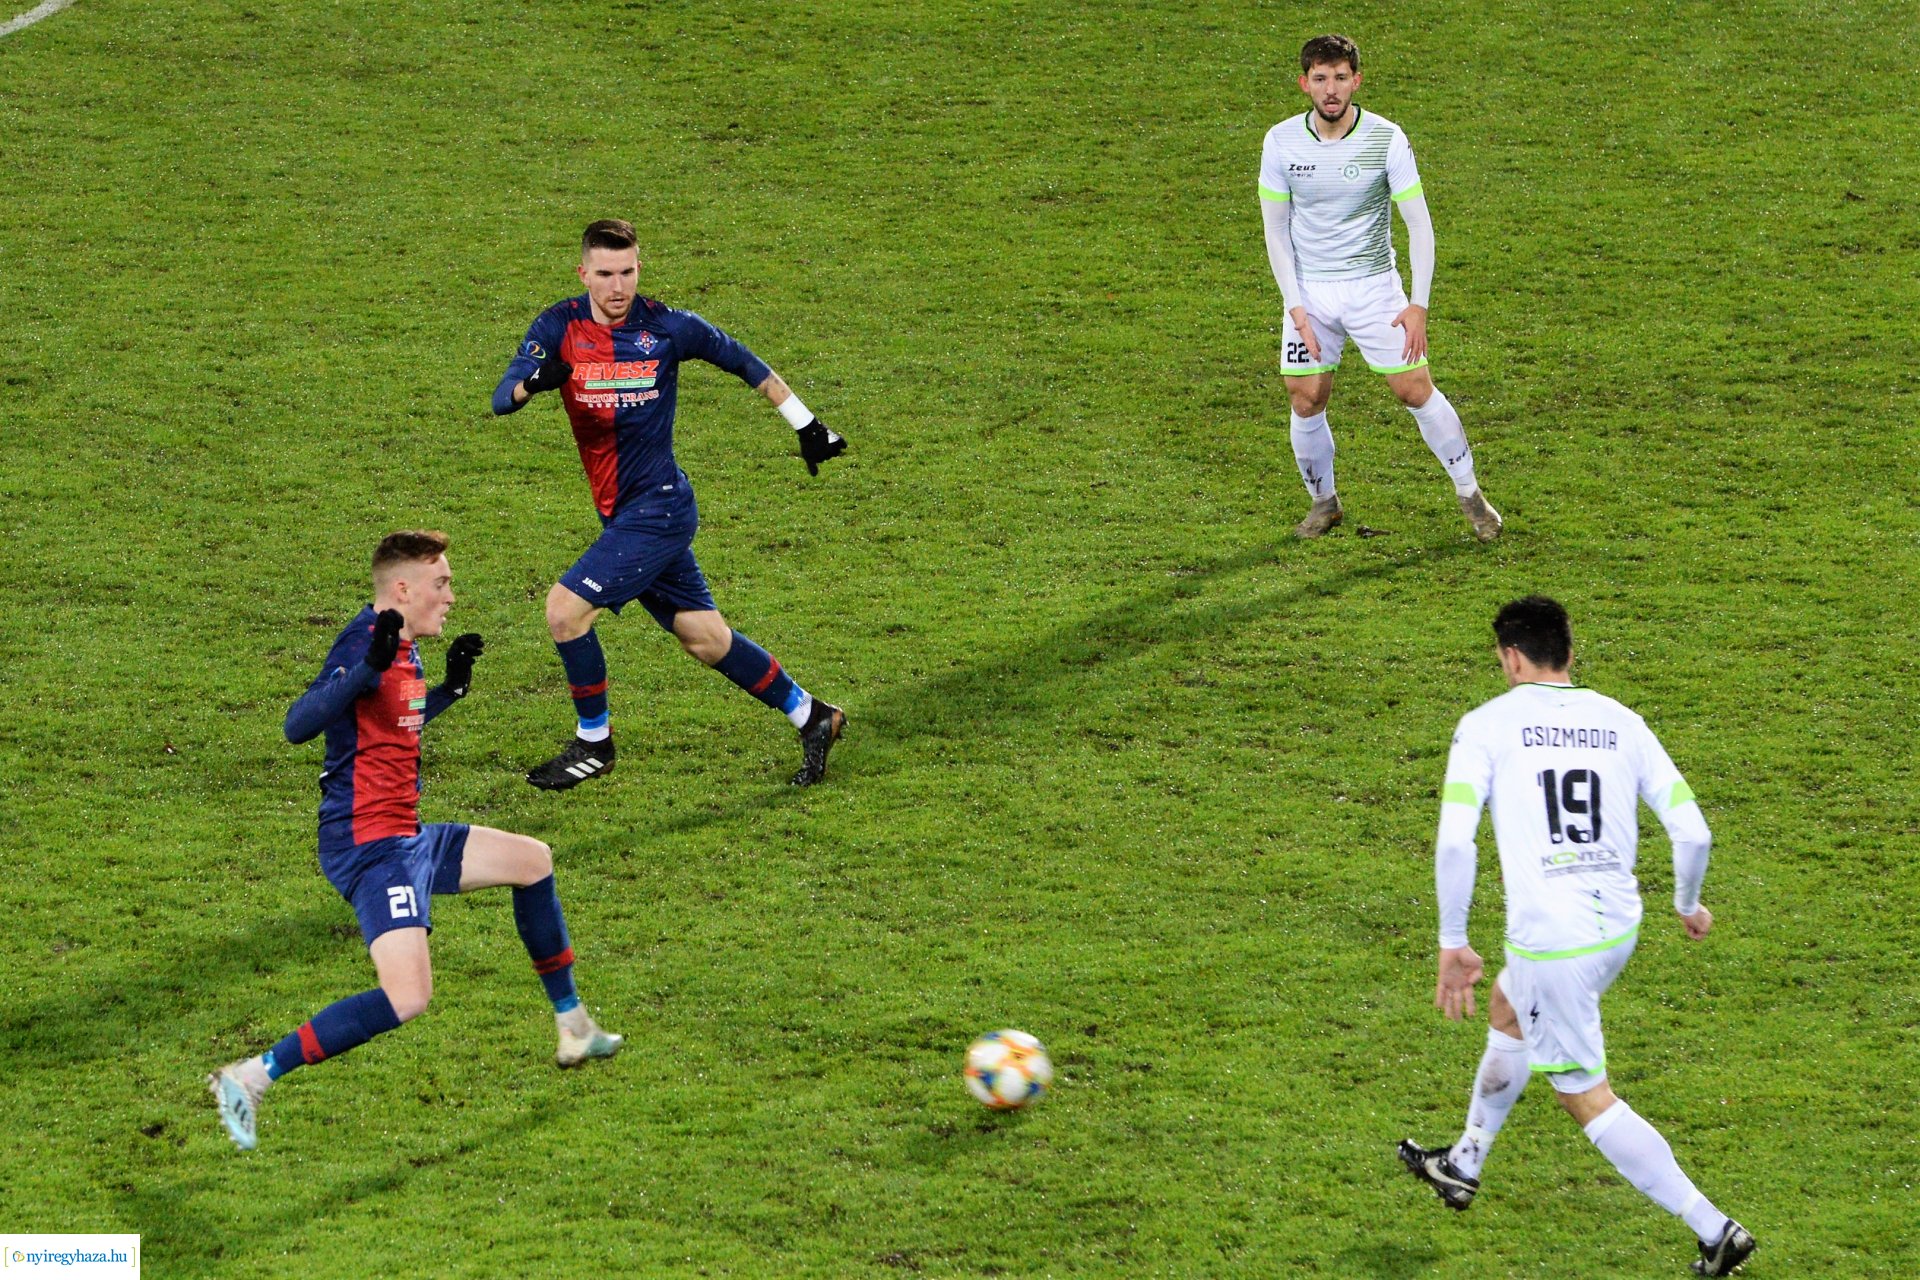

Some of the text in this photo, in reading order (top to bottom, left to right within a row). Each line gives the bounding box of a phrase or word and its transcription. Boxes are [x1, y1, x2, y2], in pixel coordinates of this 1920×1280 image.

[1287, 342, 1310, 363] 22
[572, 360, 660, 380] REVESZ
[620, 389, 660, 403] TRANS
[582, 577, 603, 592] JAKO
[1522, 726, 1618, 751] CSIZMADIA
[1536, 769, 1602, 844] 19
[1540, 850, 1620, 867] KONTEX
[387, 885, 418, 919] 21
